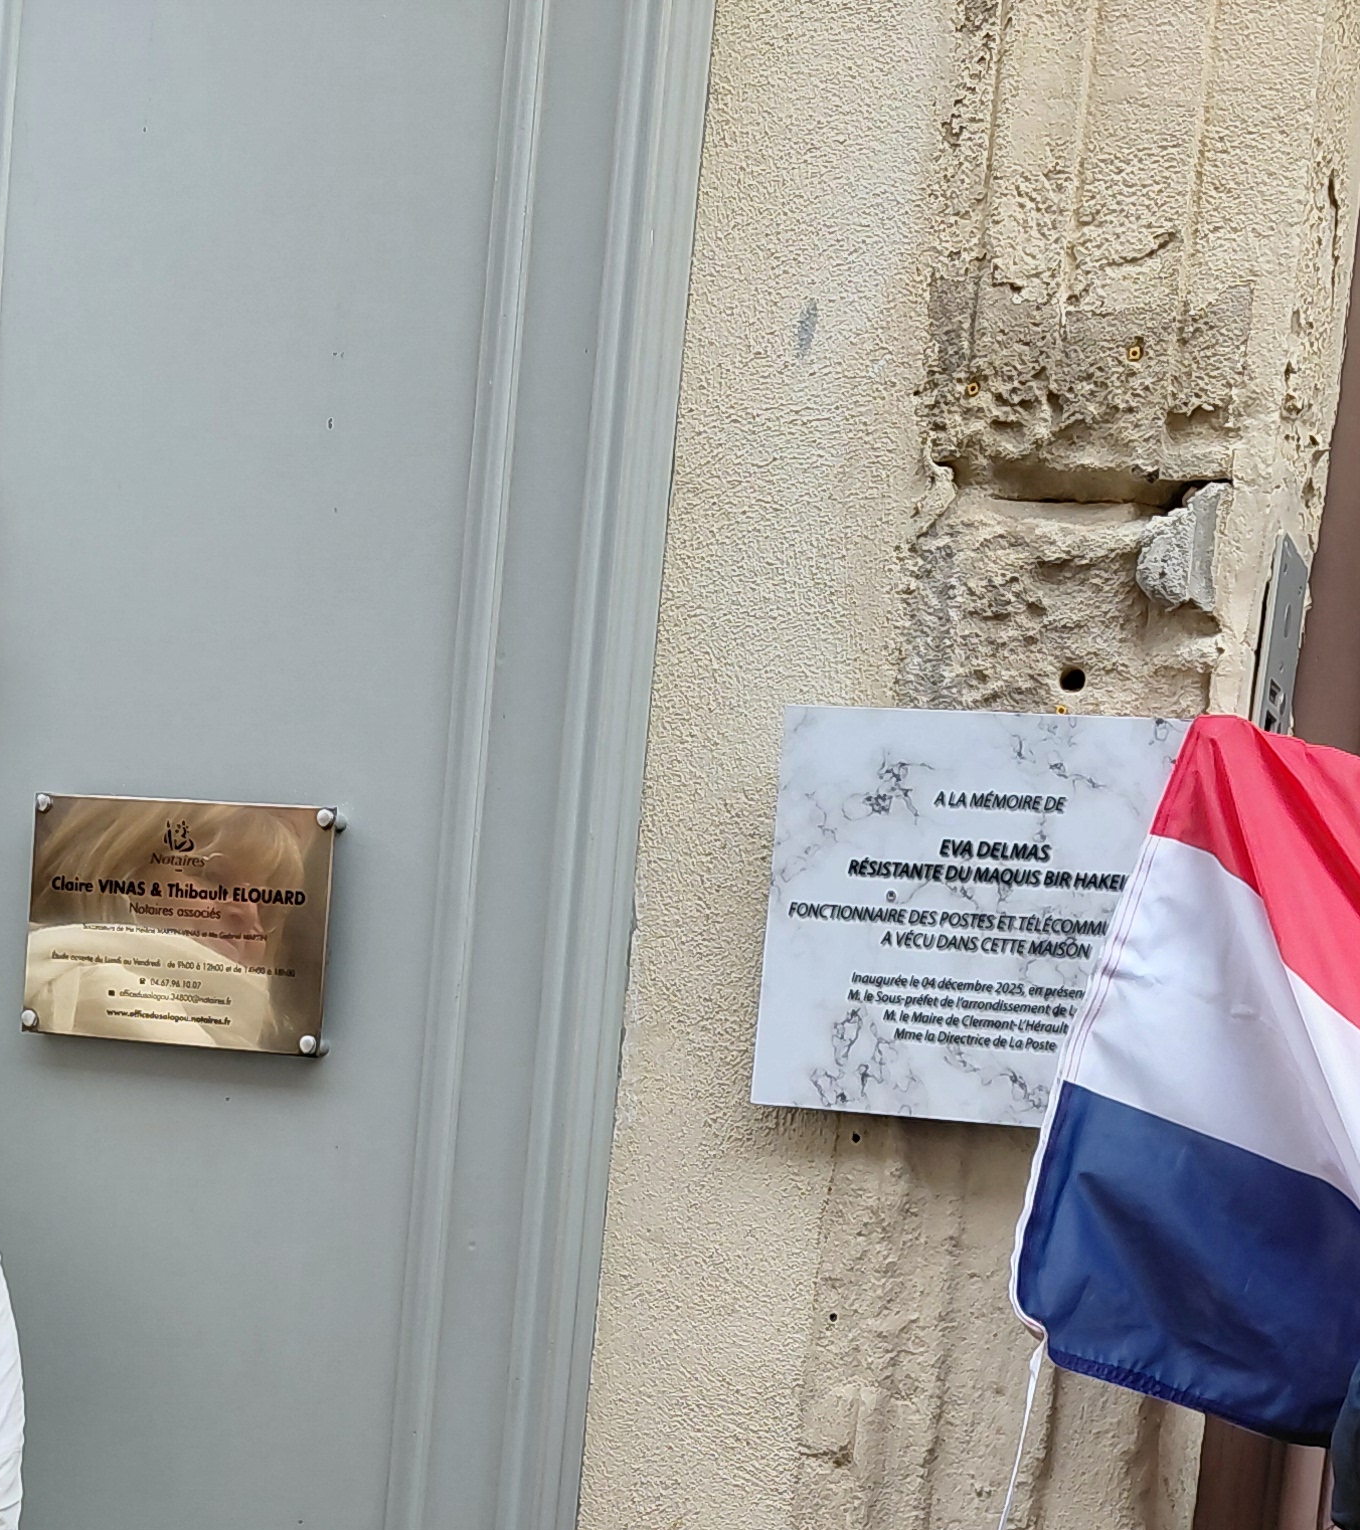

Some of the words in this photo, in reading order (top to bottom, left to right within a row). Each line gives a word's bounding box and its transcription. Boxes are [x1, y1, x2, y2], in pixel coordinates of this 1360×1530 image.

[934, 792, 947, 806] A
[949, 792, 968, 808] LA
[970, 791, 1042, 811] MÉMOIRE
[1044, 795, 1066, 812] DE
[149, 853, 206, 868] Notaires
[940, 839, 973, 858] EVA
[977, 840, 1050, 862] DELMAS
[849, 860, 943, 881] RÉSISTANTE
[947, 865, 971, 883] DU
[974, 866, 1041, 887] MAQUIS
[1044, 870, 1072, 888] BIR
[52, 877, 93, 893] Claire
[98, 879, 145, 896] VINAS
[151, 883, 162, 897] &
[168, 884, 229, 902] Thibault
[233, 887, 305, 905] ELOUARD
[129, 902, 174, 917] Notaires
[177, 906, 221, 919] associés
[789, 902, 907, 924] FONCTIONNAIRE
[909, 910, 937, 926] DES
[940, 911, 995, 929] POSTES
[998, 912, 1017, 931] ET
[881, 931, 893, 945] A
[896, 928, 935, 949] VÉCU
[937, 934, 979, 952] DANS
[981, 936, 1025, 956] CETTE
[1028, 938, 1091, 959] MAISON
[167, 961, 175, 969] de
[195, 962, 201, 971] à
[851, 971, 908, 993] Inaugurée
[909, 976, 920, 990] le
[922, 976, 935, 992] 04
[937, 978, 993, 995] décembre
[995, 981, 1025, 999] 2025,
[1029, 988, 1043, 999] en
[847, 989, 860, 1002] M.
[863, 990, 873, 1003] le
[875, 991, 939, 1011] Sous-préfet
[940, 993, 955, 1007] de
[957, 995, 1050, 1017] l'arrondissement
[1052, 1001, 1066, 1017] de
[883, 1010, 896, 1023] M.
[899, 1012, 909, 1024] le
[911, 1013, 944, 1027] Maire
[946, 1016, 960, 1028] de
[893, 1028, 922, 1042] Mme
[925, 1030, 935, 1043] la
[936, 1032, 990, 1049] Directrice
[993, 1035, 1007, 1049] de
[1009, 1036, 1022, 1050] La
[1025, 1038, 1058, 1053] Poste
